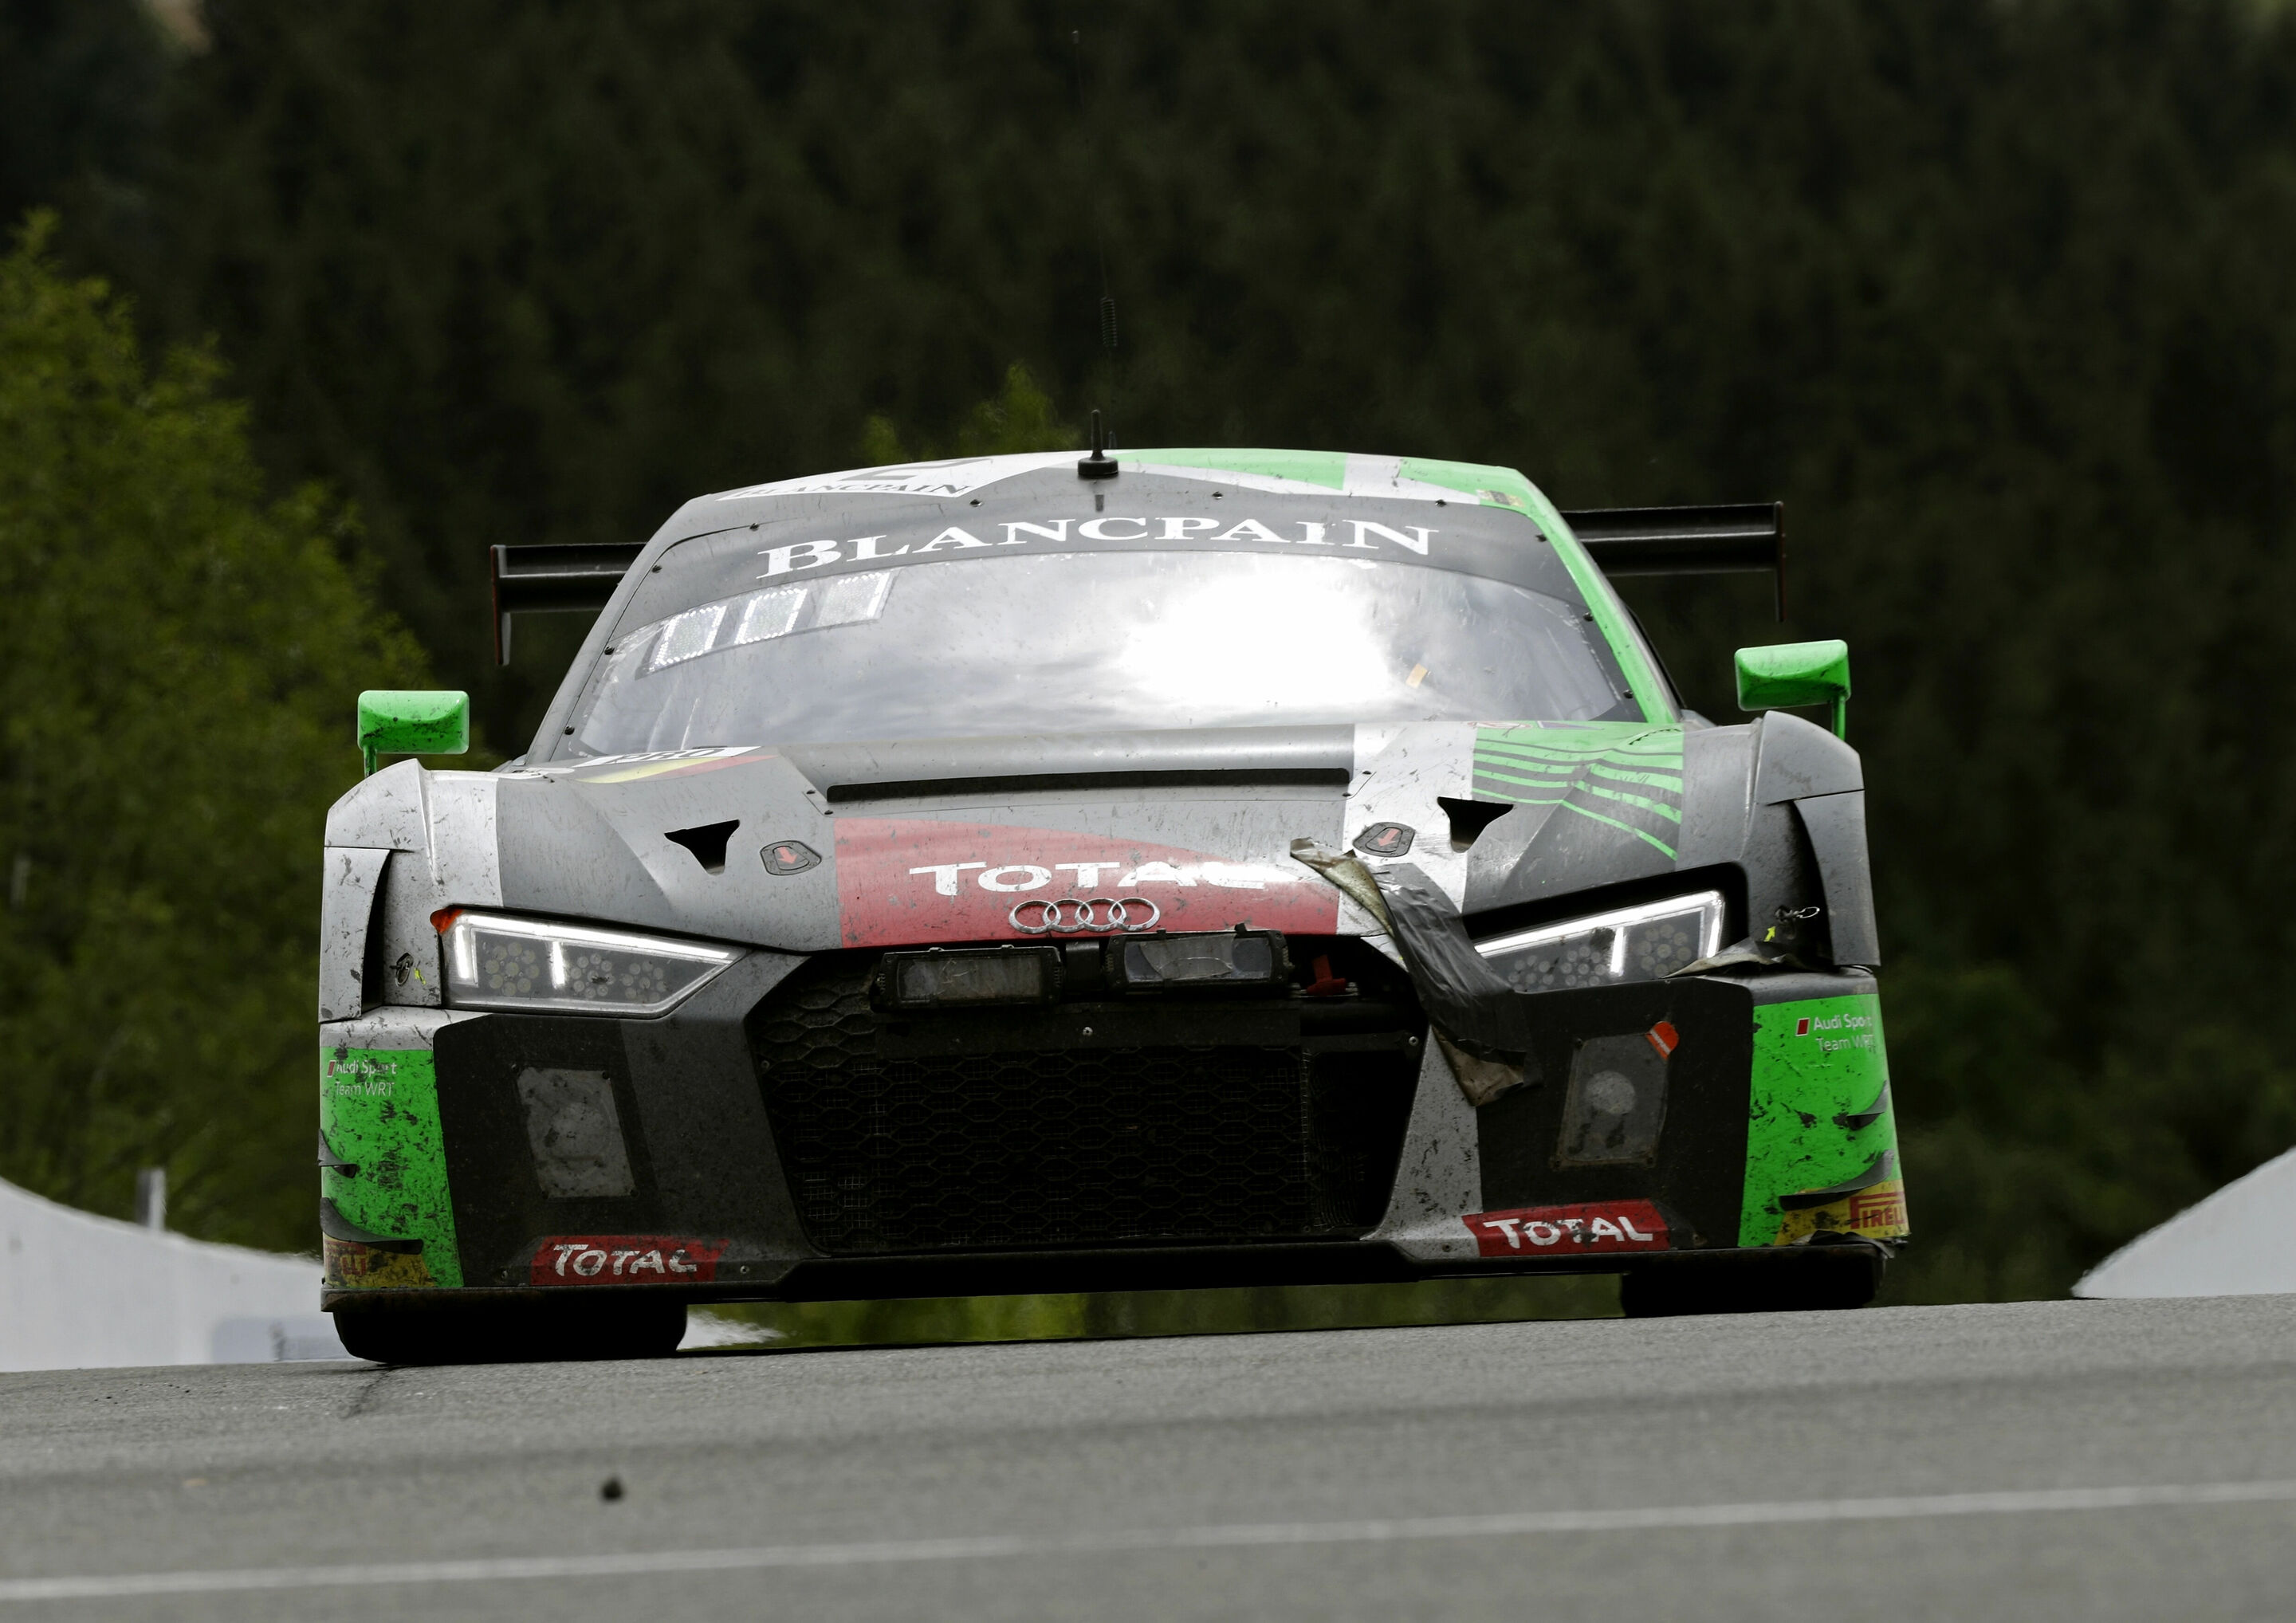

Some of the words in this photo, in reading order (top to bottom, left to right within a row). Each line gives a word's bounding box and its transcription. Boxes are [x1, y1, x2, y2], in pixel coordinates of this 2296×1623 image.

[756, 517, 1440, 580] BLANCPAIN
[909, 861, 1266, 897] TOTAL
[1813, 1014, 1842, 1031] Audi
[1815, 1036, 1851, 1052] Team
[336, 1059, 360, 1075] Audi
[335, 1081, 362, 1096] Team
[364, 1081, 395, 1098] WRT
[1482, 1216, 1654, 1250] TOTAL
[552, 1244, 698, 1277] TOTAL
